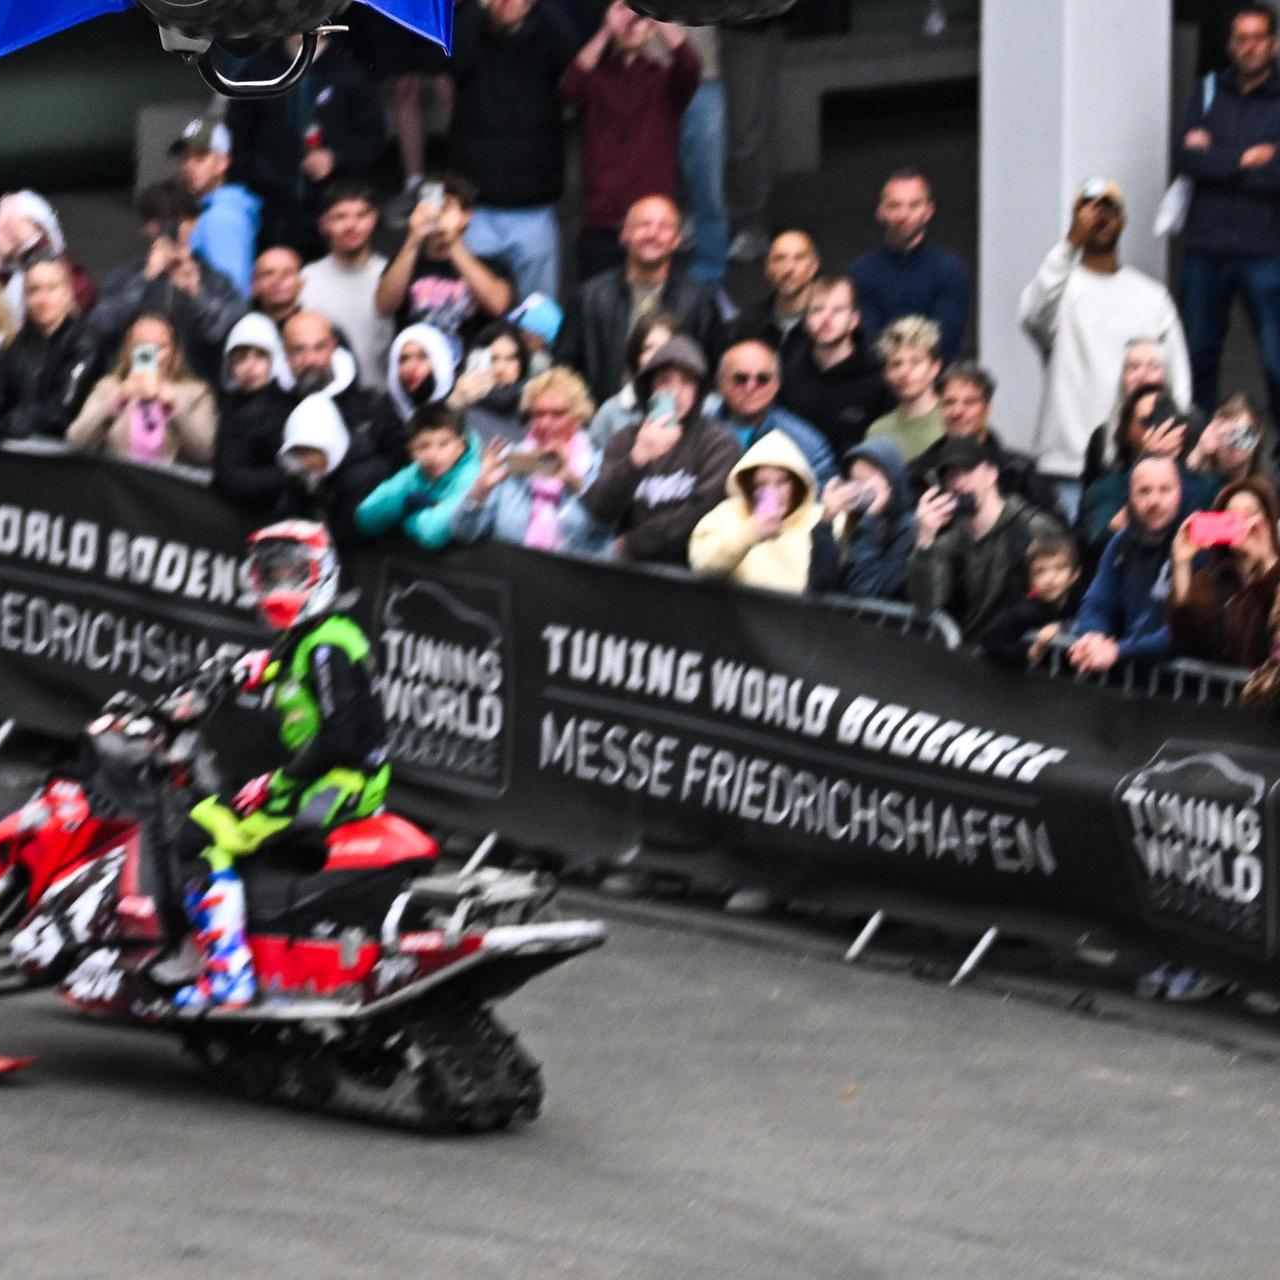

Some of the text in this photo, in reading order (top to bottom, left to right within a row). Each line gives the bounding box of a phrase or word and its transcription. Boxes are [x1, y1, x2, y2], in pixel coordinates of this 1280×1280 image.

[106, 528, 258, 612] BODENS
[381, 629, 504, 693] TUNING
[372, 673, 504, 741] WORLD
[542, 624, 1068, 783] TUNING WORLD BODENSEE
[539, 711, 672, 798] MESSE
[681, 745, 1058, 876] FRIEDRICHSHAFEN
[1121, 786, 1262, 854] TUNING
[1132, 833, 1263, 904] WORLD
